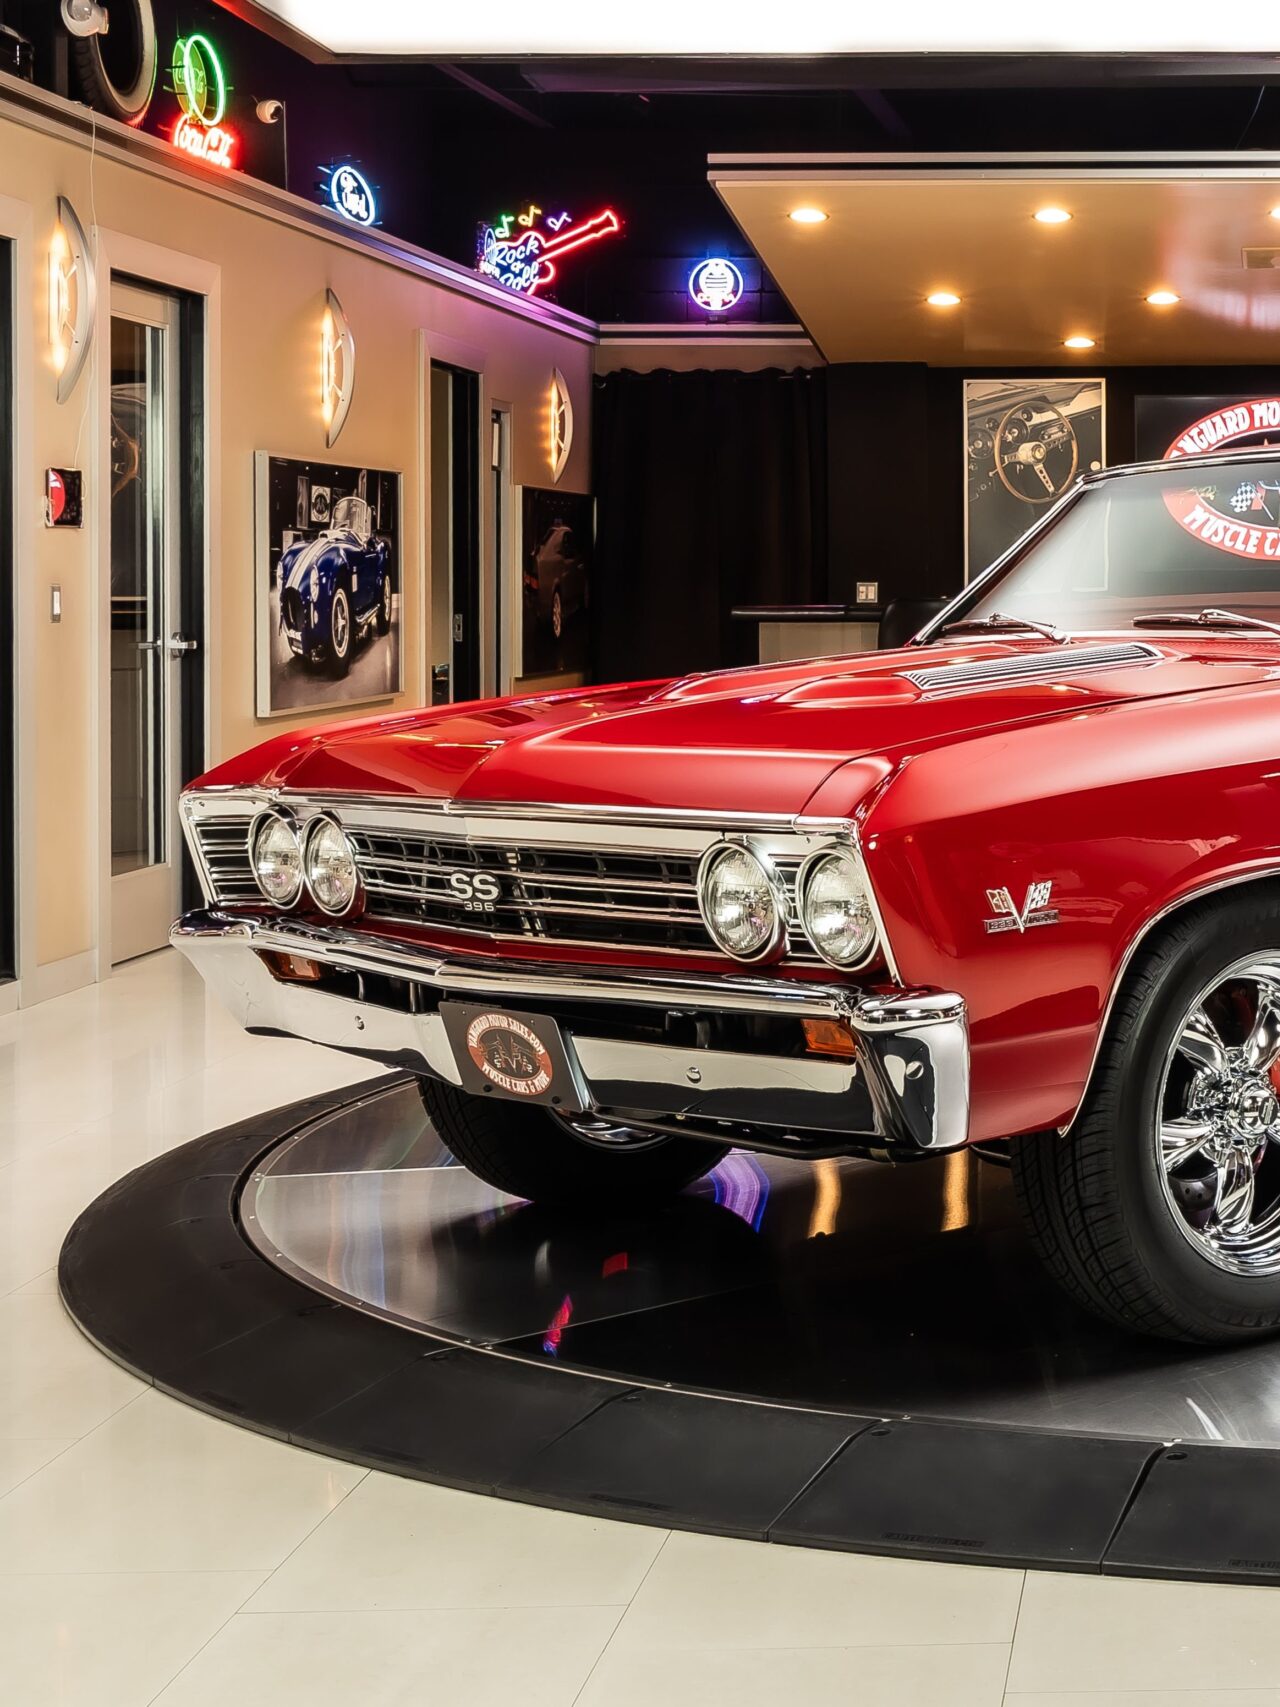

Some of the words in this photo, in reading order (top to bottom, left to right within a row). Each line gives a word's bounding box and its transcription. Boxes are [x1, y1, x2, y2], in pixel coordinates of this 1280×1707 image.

[491, 234, 540, 266] Rock
[1168, 405, 1251, 458] NGUARD
[1183, 504, 1262, 555] MUSCLE
[450, 873, 499, 900] SS
[463, 901, 495, 912] 396
[508, 1017, 546, 1055] SALES.COM
[481, 1062, 511, 1090] MUSCLE
[511, 1080, 530, 1094] CARS
